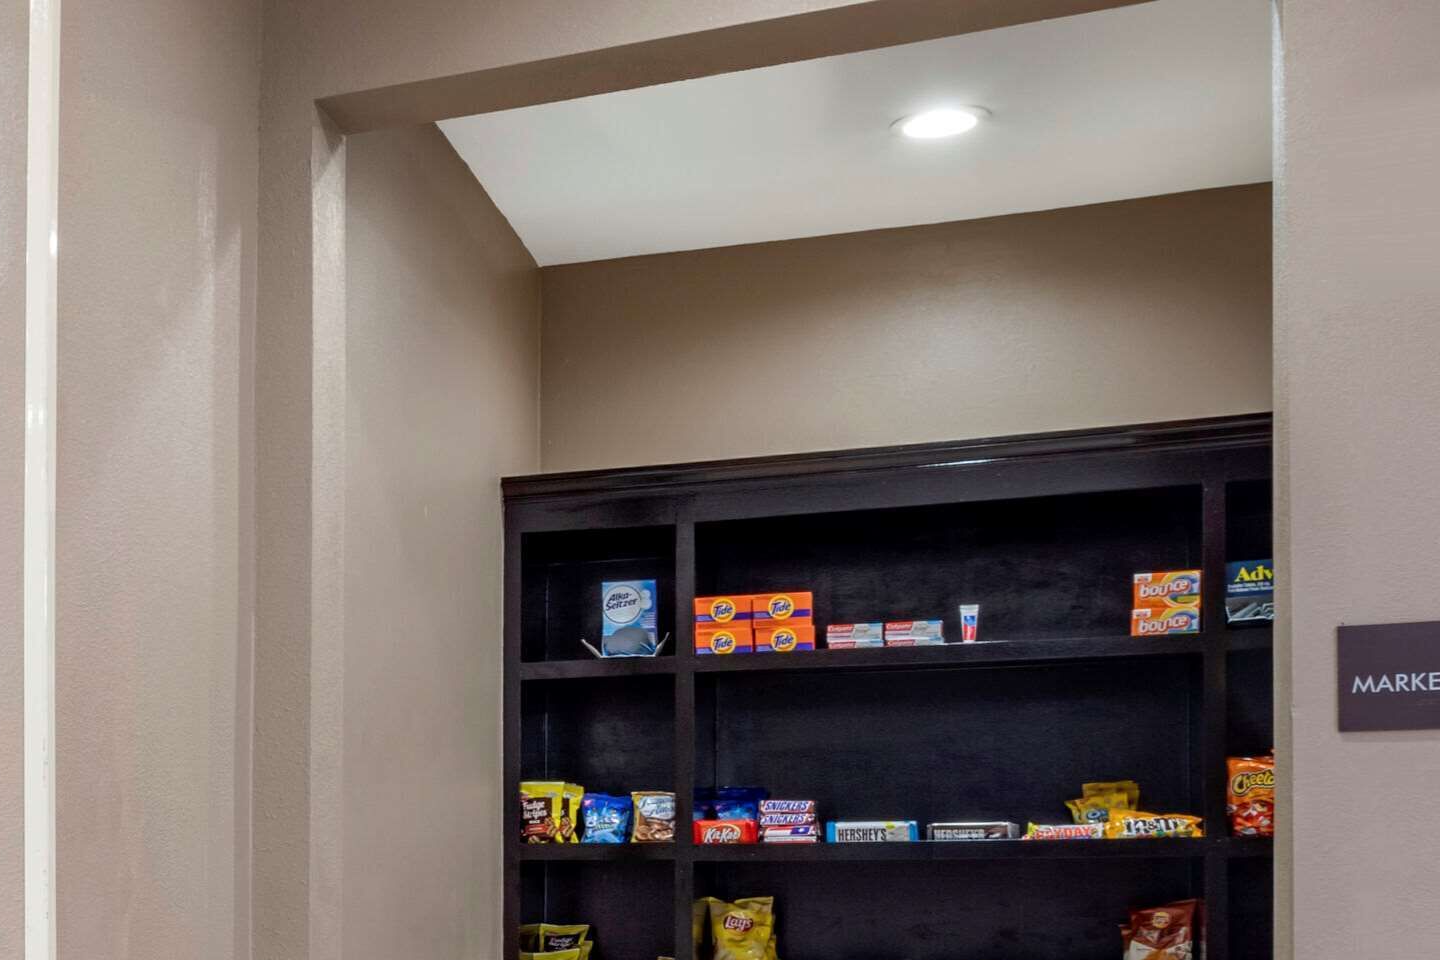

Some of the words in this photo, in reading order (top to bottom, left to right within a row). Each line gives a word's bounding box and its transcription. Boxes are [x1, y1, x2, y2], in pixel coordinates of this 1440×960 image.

[713, 604, 733, 617] Tide
[771, 601, 791, 614] Tide
[713, 637, 733, 650] Tide
[774, 634, 794, 648] Tide
[1352, 672, 1440, 693] MARKE
[765, 801, 809, 811] SNICKERS
